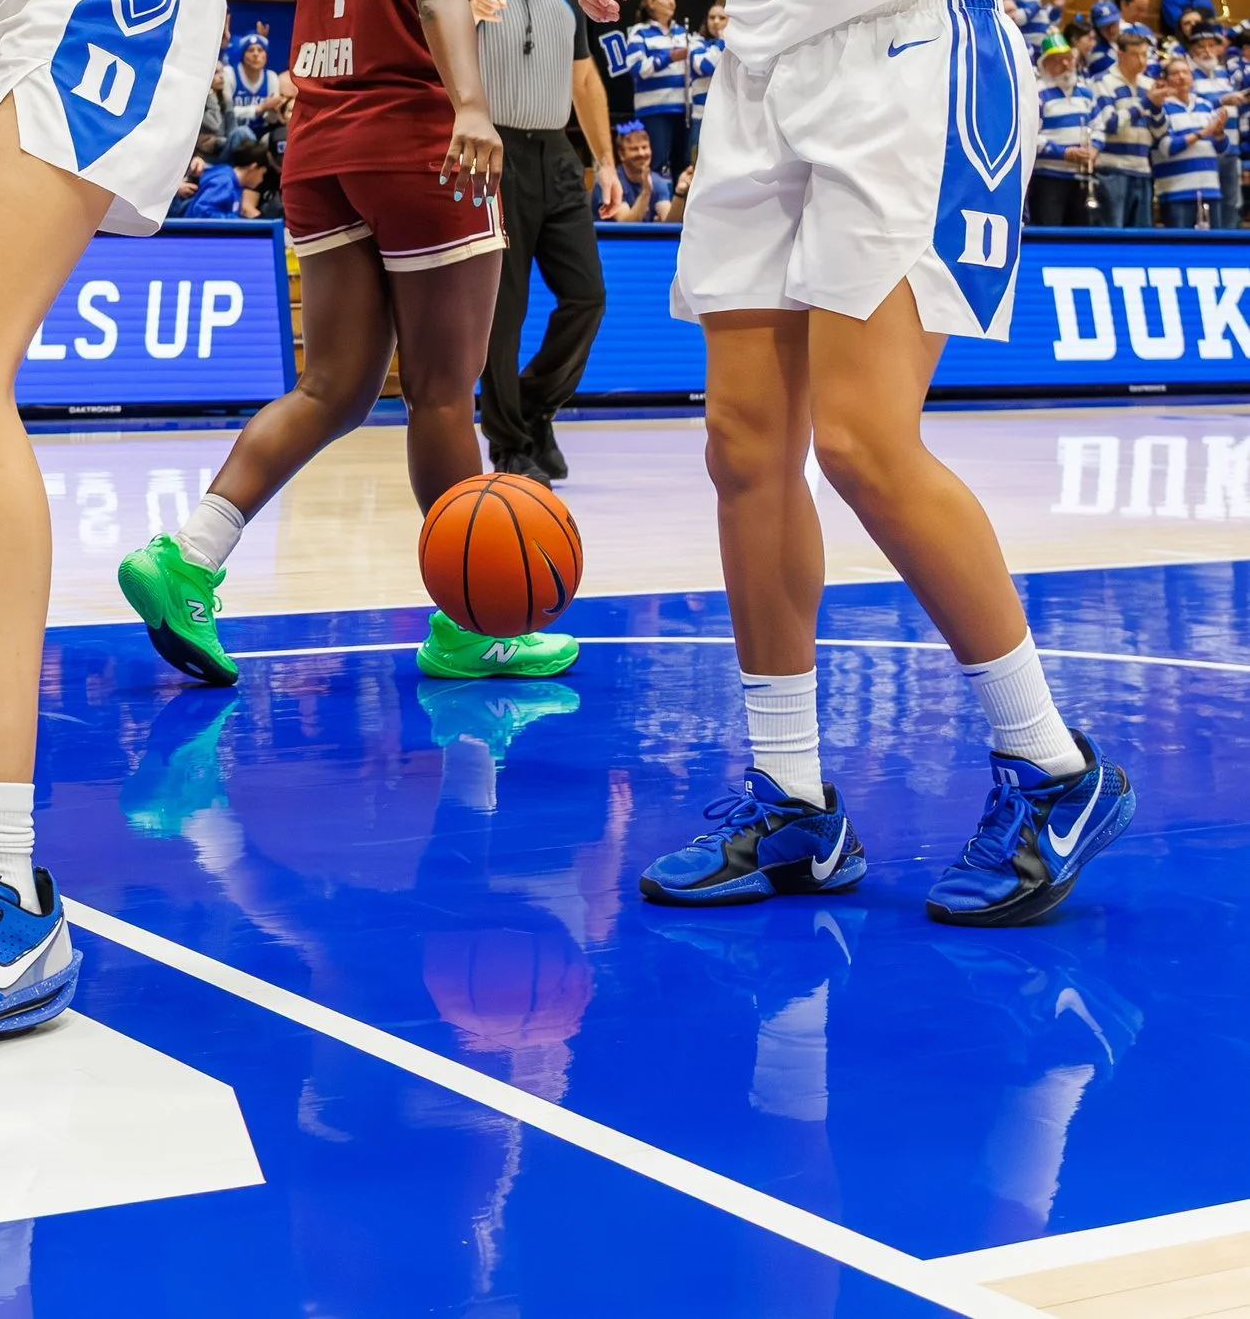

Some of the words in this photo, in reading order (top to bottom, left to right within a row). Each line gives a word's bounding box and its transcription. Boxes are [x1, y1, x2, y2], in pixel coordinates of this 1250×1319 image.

[70, 42, 136, 117] D
[956, 209, 1009, 269] D
[145, 280, 244, 359] UP
[1041, 266, 1250, 361] DUK
[481, 642, 518, 663] N
